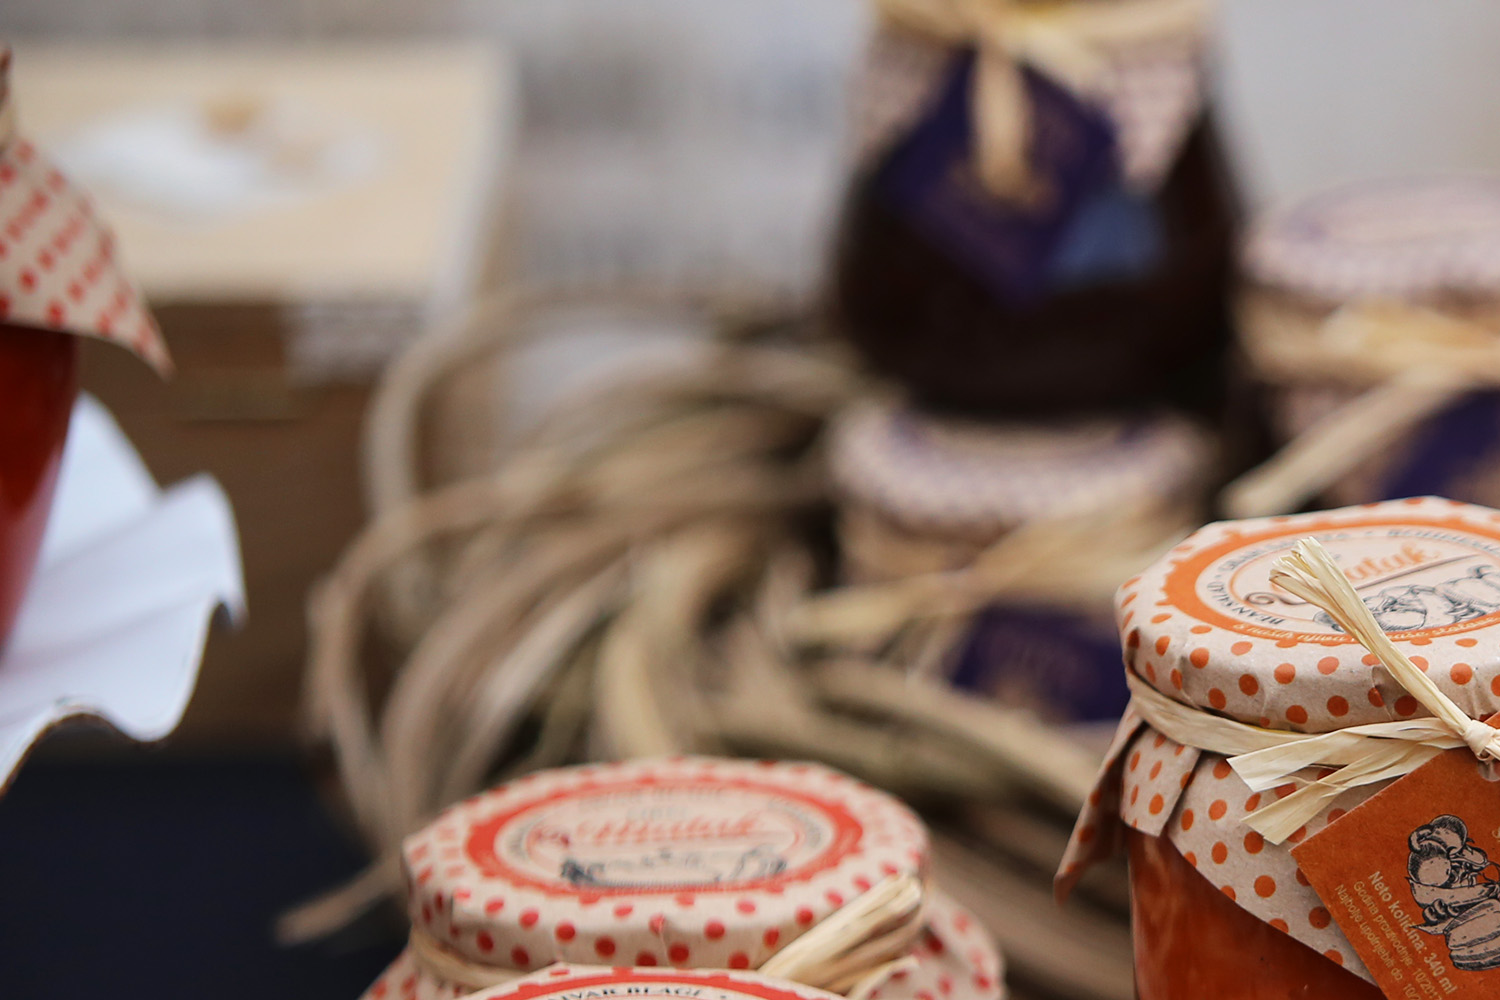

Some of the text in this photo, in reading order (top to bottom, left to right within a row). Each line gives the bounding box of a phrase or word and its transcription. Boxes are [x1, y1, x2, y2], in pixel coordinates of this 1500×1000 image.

[1334, 884, 1364, 923] Najbolje
[1353, 880, 1379, 916] Godina
[1368, 870, 1392, 902] Neto
[1423, 952, 1446, 977] 340
[1438, 976, 1458, 995] ml
